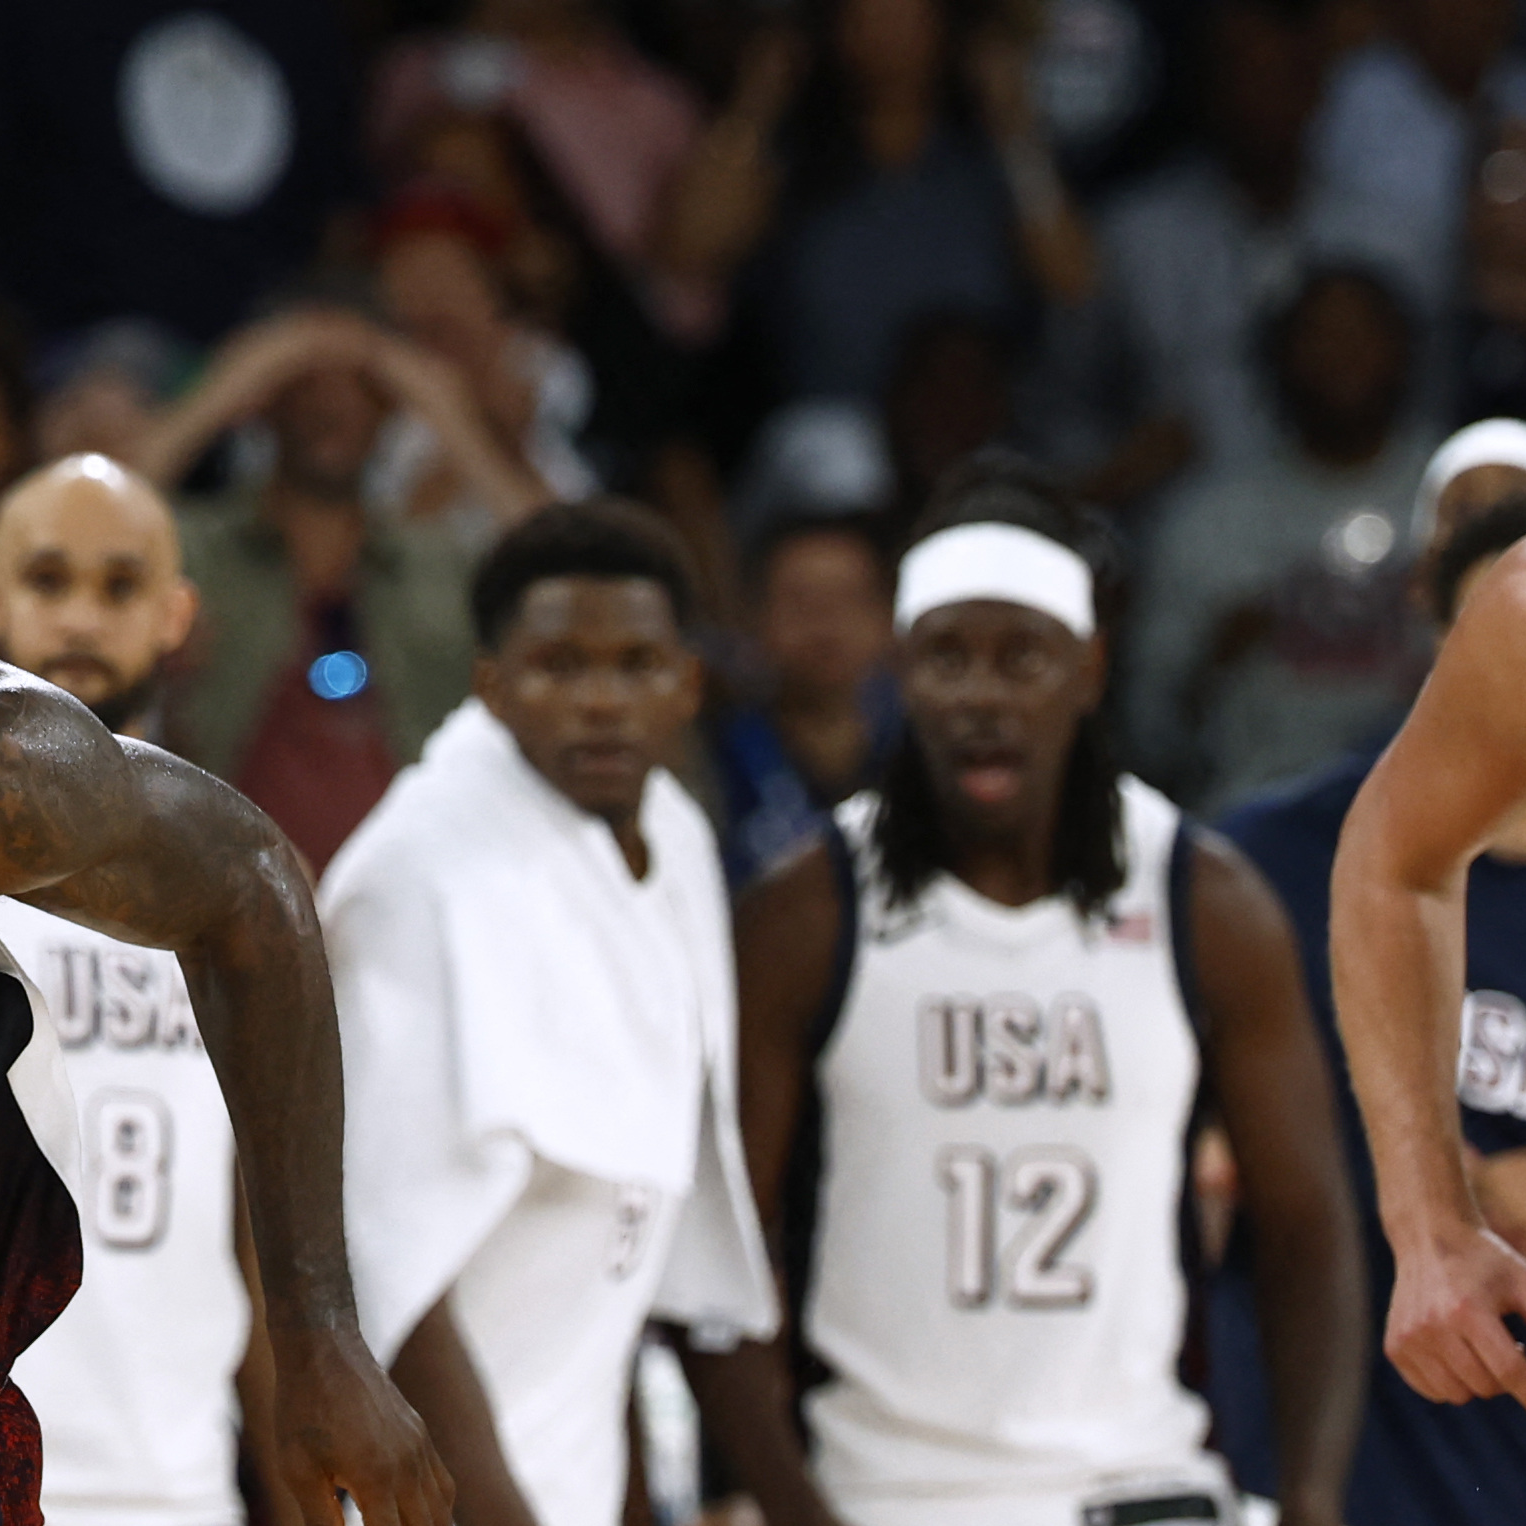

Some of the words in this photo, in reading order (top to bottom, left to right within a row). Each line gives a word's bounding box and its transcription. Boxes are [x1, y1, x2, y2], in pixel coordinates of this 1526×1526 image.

[917, 991, 1111, 1108] USA
[85, 1086, 175, 1252] 8
[937, 1143, 1099, 1312] 12
